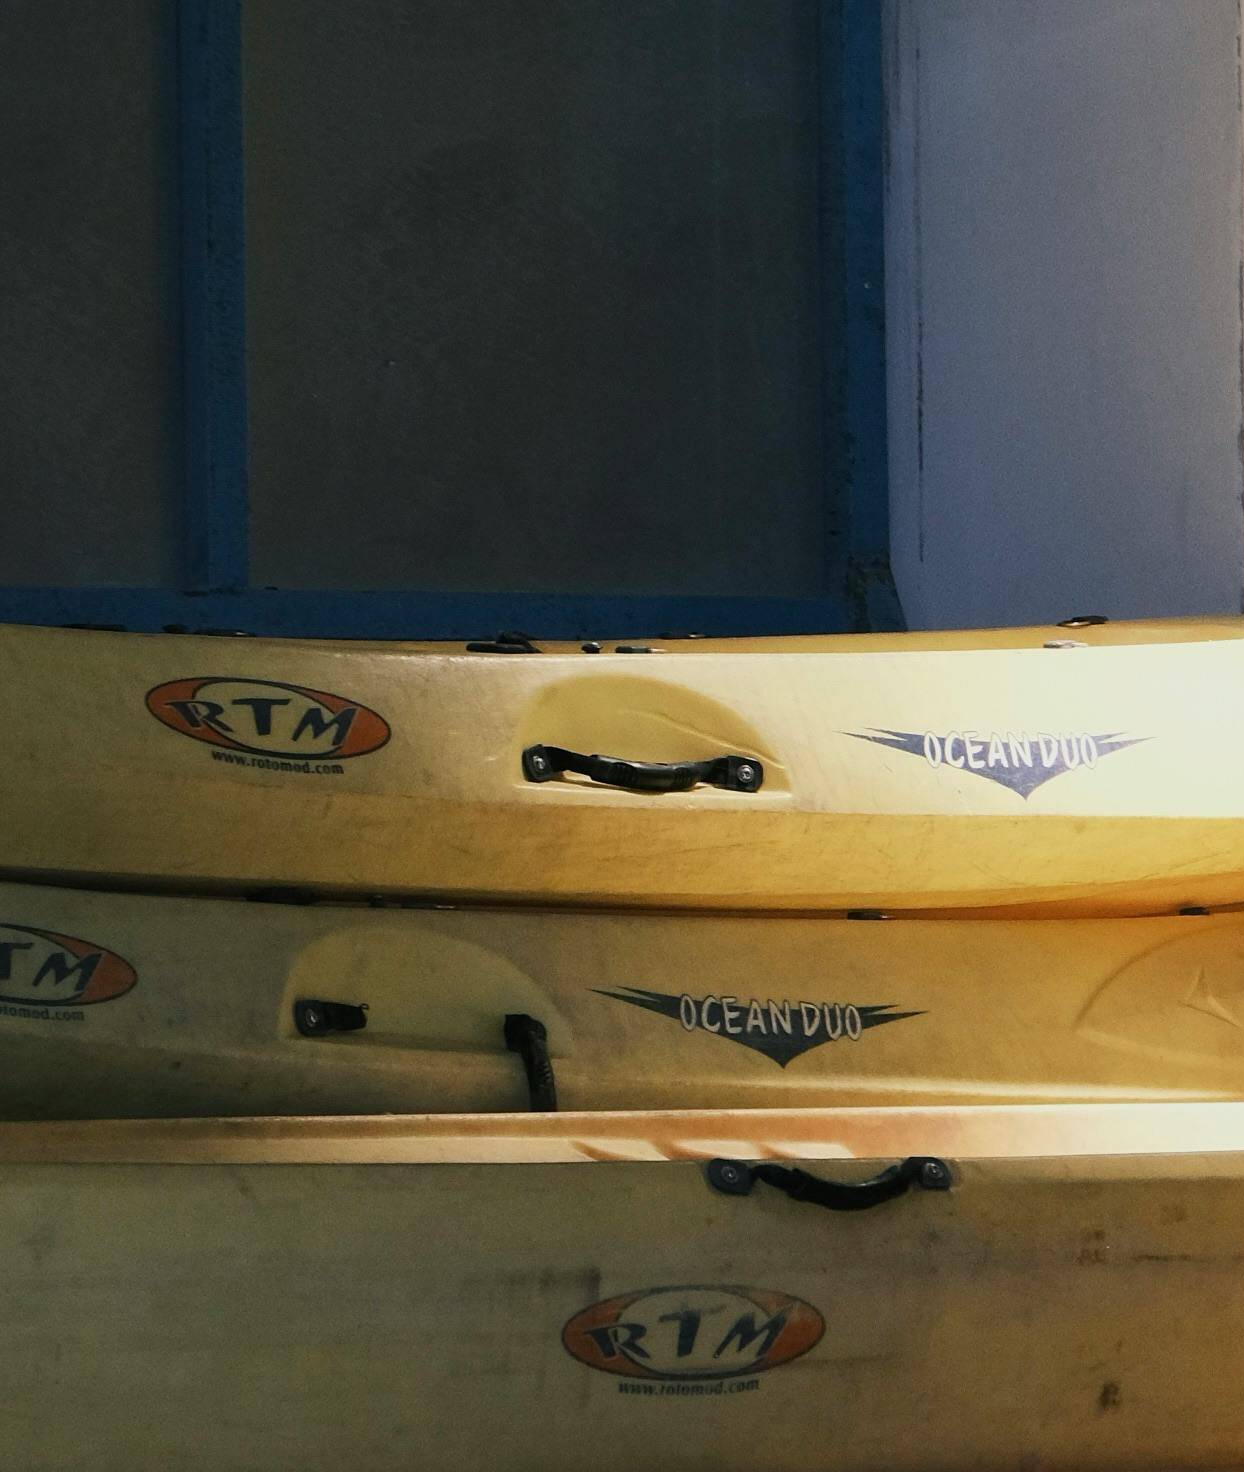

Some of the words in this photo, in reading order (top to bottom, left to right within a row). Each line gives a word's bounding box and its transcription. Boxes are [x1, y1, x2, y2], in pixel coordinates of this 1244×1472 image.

[164, 698, 357, 746] RTM
[211, 750, 345, 774] www.rotomod.com
[583, 1307, 791, 1360] RTM
